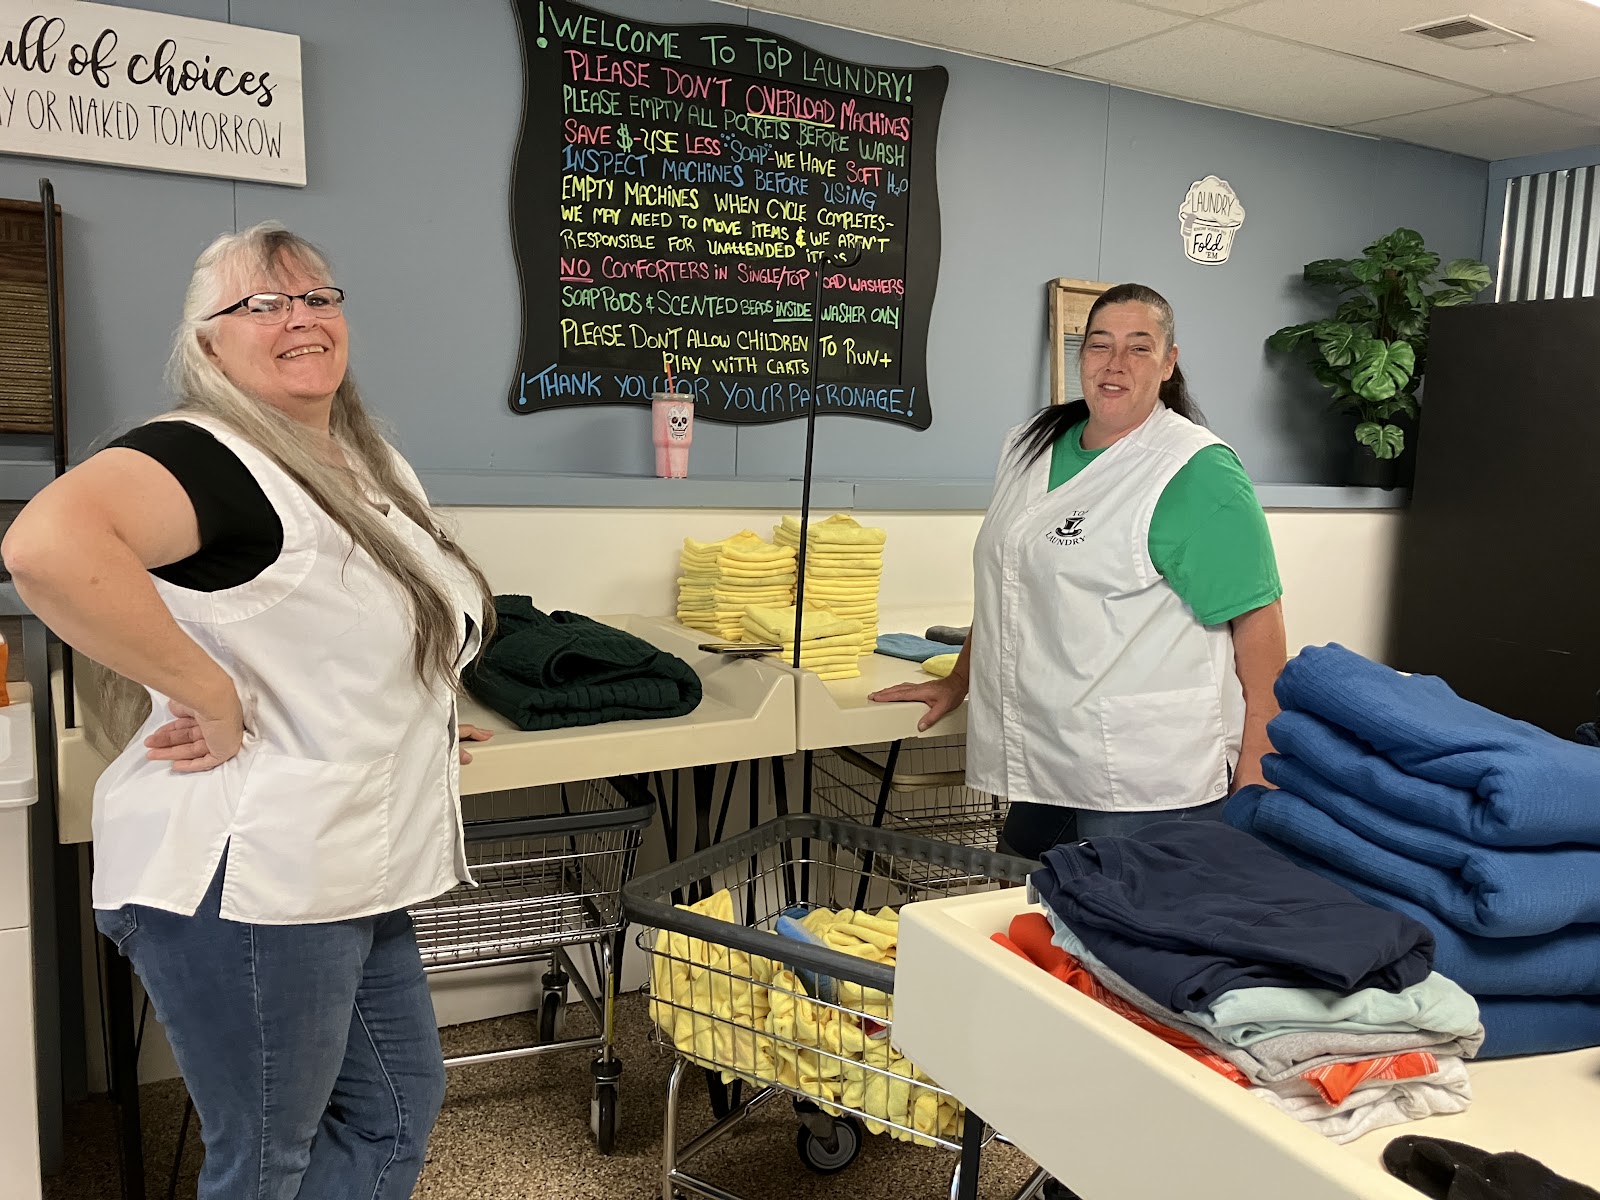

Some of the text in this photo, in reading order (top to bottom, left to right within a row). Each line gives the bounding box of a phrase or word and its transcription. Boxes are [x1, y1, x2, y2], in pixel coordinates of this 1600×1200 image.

[68, 29, 118, 88] of
[127, 39, 278, 107] choices
[564, 50, 650, 88] PLEASE
[660, 67, 733, 107] DON'T
[746, 85, 836, 124] OVERLOAD
[700, 35, 736, 66] TO
[745, 38, 793, 78] TOP
[803, 51, 913, 103] LAUNDRY!
[27, 89, 62, 132] OR
[69, 95, 139, 141] NAKED
[147, 105, 282, 159] TOMORROW
[563, 84, 906, 168] PLEASE EMPTY ALL POCKETS BEFORE WASH
[562, 144, 648, 177] INSPECT
[754, 169, 809, 196] BEFORE
[564, 118, 612, 146] SAVE
[686, 133, 721, 156] LESS
[800, 151, 837, 178] HAVE
[845, 160, 883, 187] SOFT
[562, 174, 614, 202] EMPTY
[714, 192, 760, 215] WHEN
[766, 198, 807, 222] CYCLE
[1191, 191, 1235, 216] LAUNDRY
[560, 204, 583, 223] WE
[593, 207, 622, 225] MAY
[631, 212, 673, 228] NEED
[679, 215, 698, 230] TO
[703, 217, 742, 236] MOVE
[809, 231, 831, 247] WE
[667, 237, 696, 253] FOR
[1193, 232, 1224, 254] Fold
[560, 257, 592, 277] NO
[601, 256, 710, 283] COMFORTERS
[848, 277, 904, 295] WASHERS
[562, 285, 599, 310] SOAP
[599, 286, 643, 314] PODS
[657, 290, 738, 318] SCENTED
[740, 299, 774, 315] BEADS
[820, 303, 867, 323] WASHER
[870, 307, 899, 329] ONLY
[560, 318, 626, 348] PLEASE
[686, 328, 731, 348] ALLOW
[819, 335, 838, 357] TO
[662, 350, 702, 375] PLAY
[766, 358, 810, 375] CARTS
[614, 374, 659, 400] YOU
[719, 381, 785, 413] YOUR
